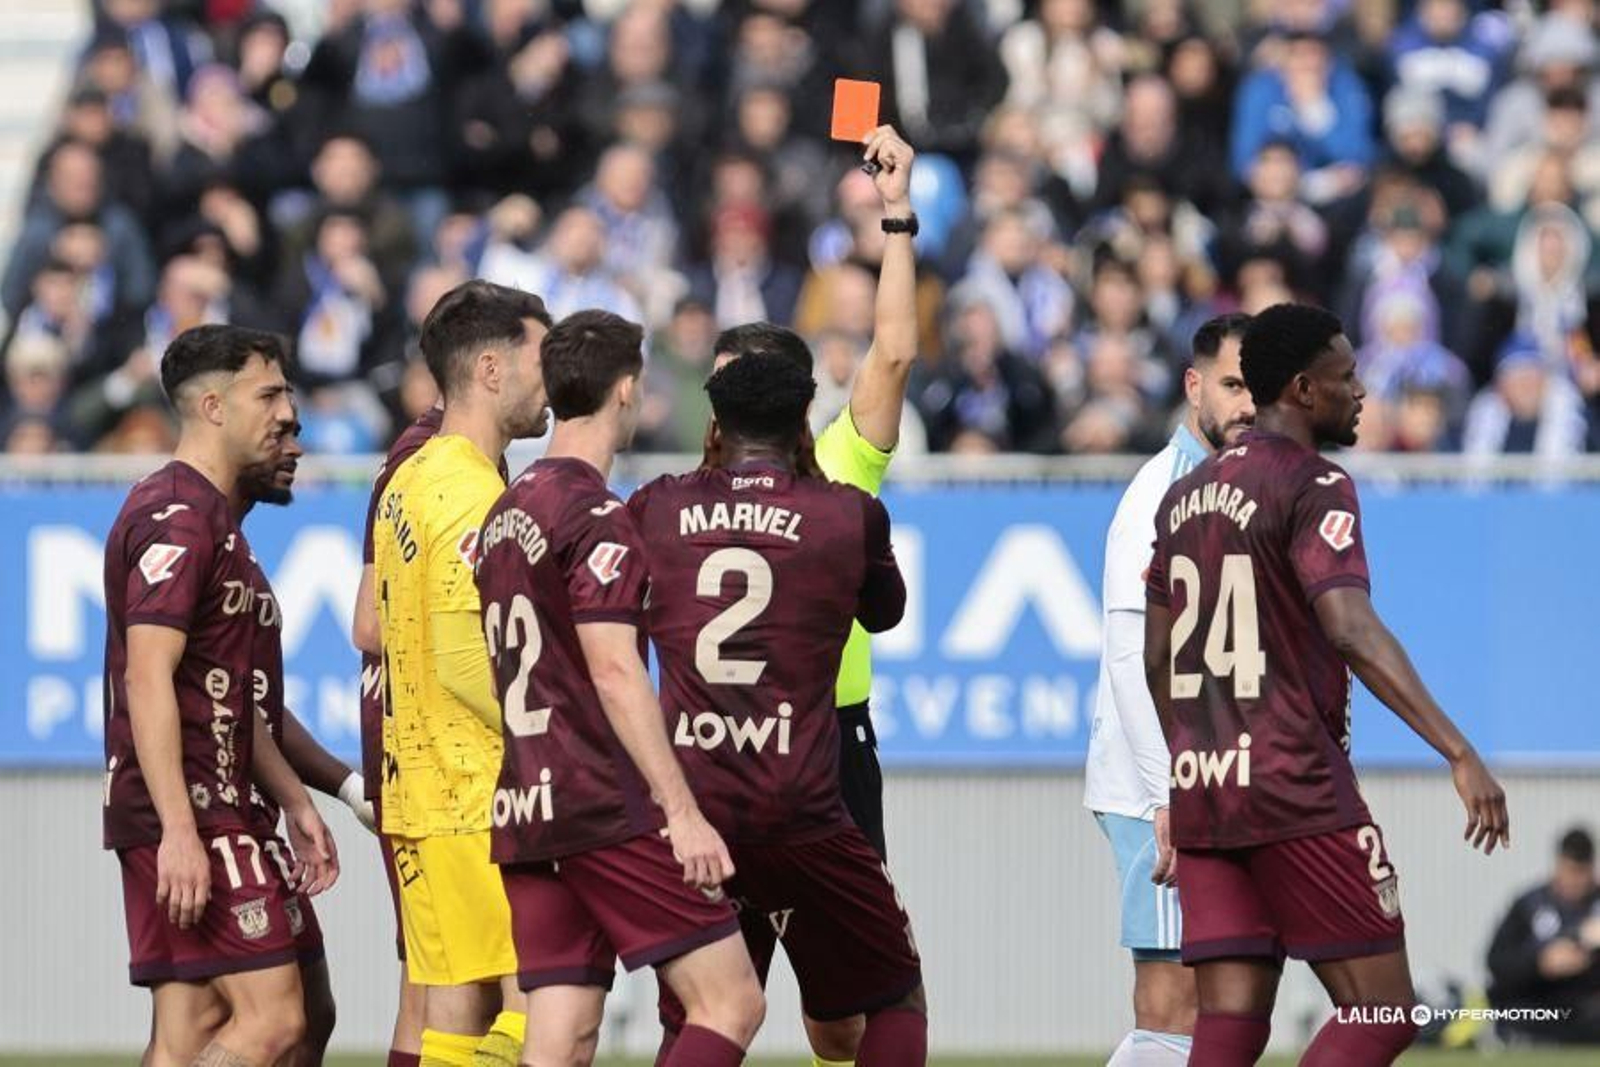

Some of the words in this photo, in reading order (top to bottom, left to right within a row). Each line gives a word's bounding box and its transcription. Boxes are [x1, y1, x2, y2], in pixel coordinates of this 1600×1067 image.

[679, 502, 803, 542] MARVEL
[1169, 482, 1258, 535] DIAWARA
[696, 547, 774, 686] 2
[1170, 553, 1267, 700] 24
[211, 834, 267, 890] 17
